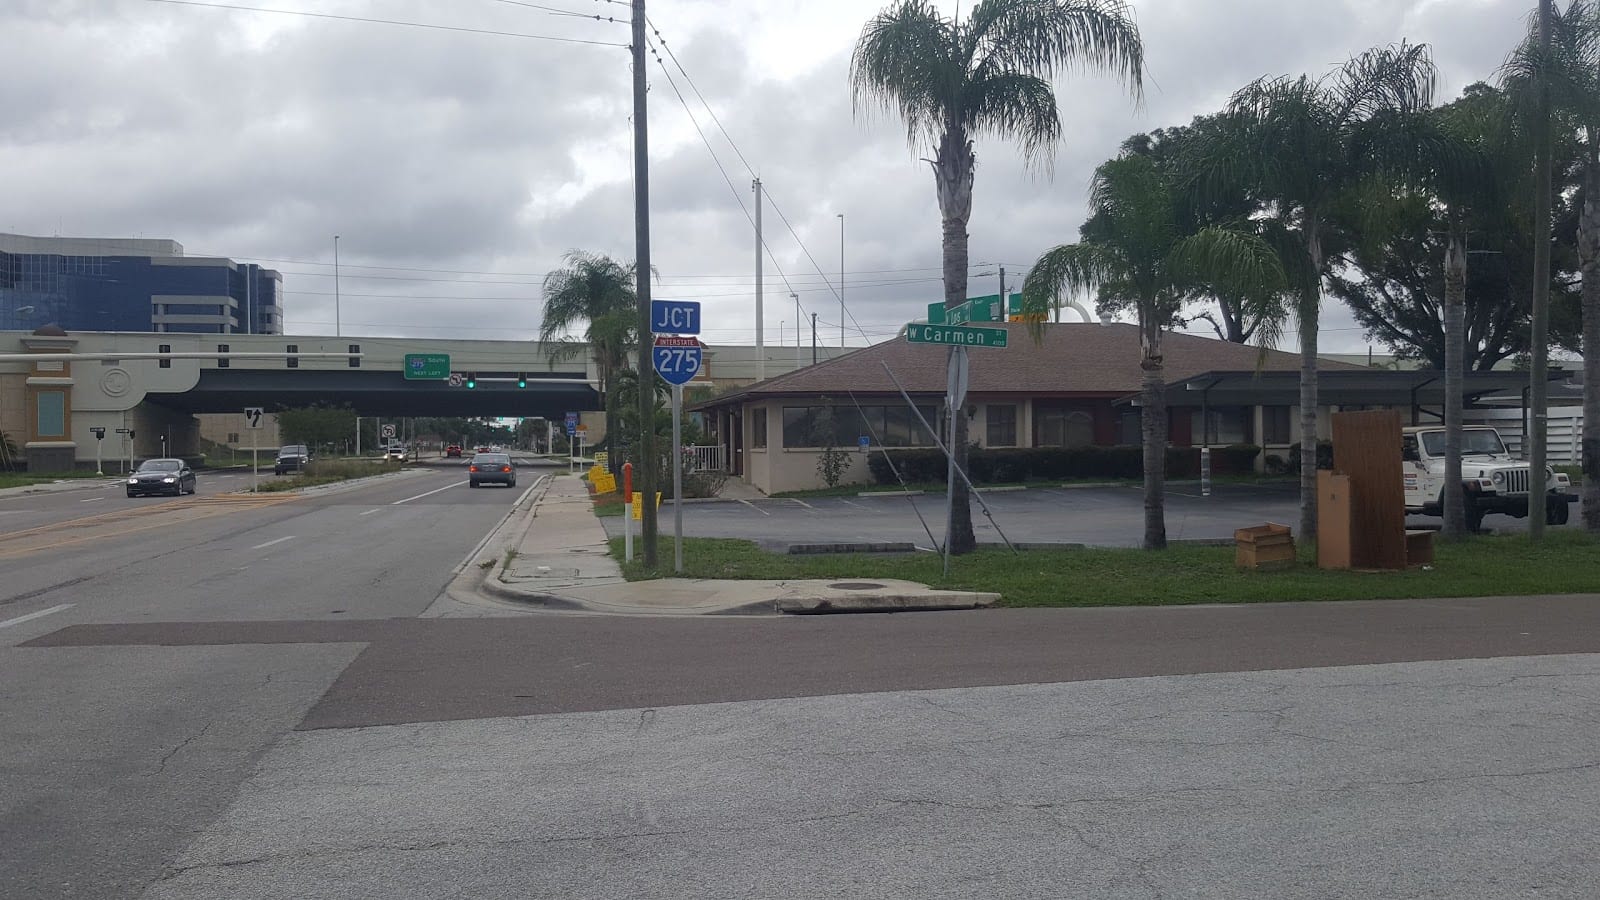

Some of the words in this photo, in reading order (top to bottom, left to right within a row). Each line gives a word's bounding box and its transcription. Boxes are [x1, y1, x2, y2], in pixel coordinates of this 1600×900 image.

[658, 307, 694, 328] JCT
[909, 328, 917, 338] W
[924, 327, 984, 344] Carmen
[659, 349, 698, 373] 275
